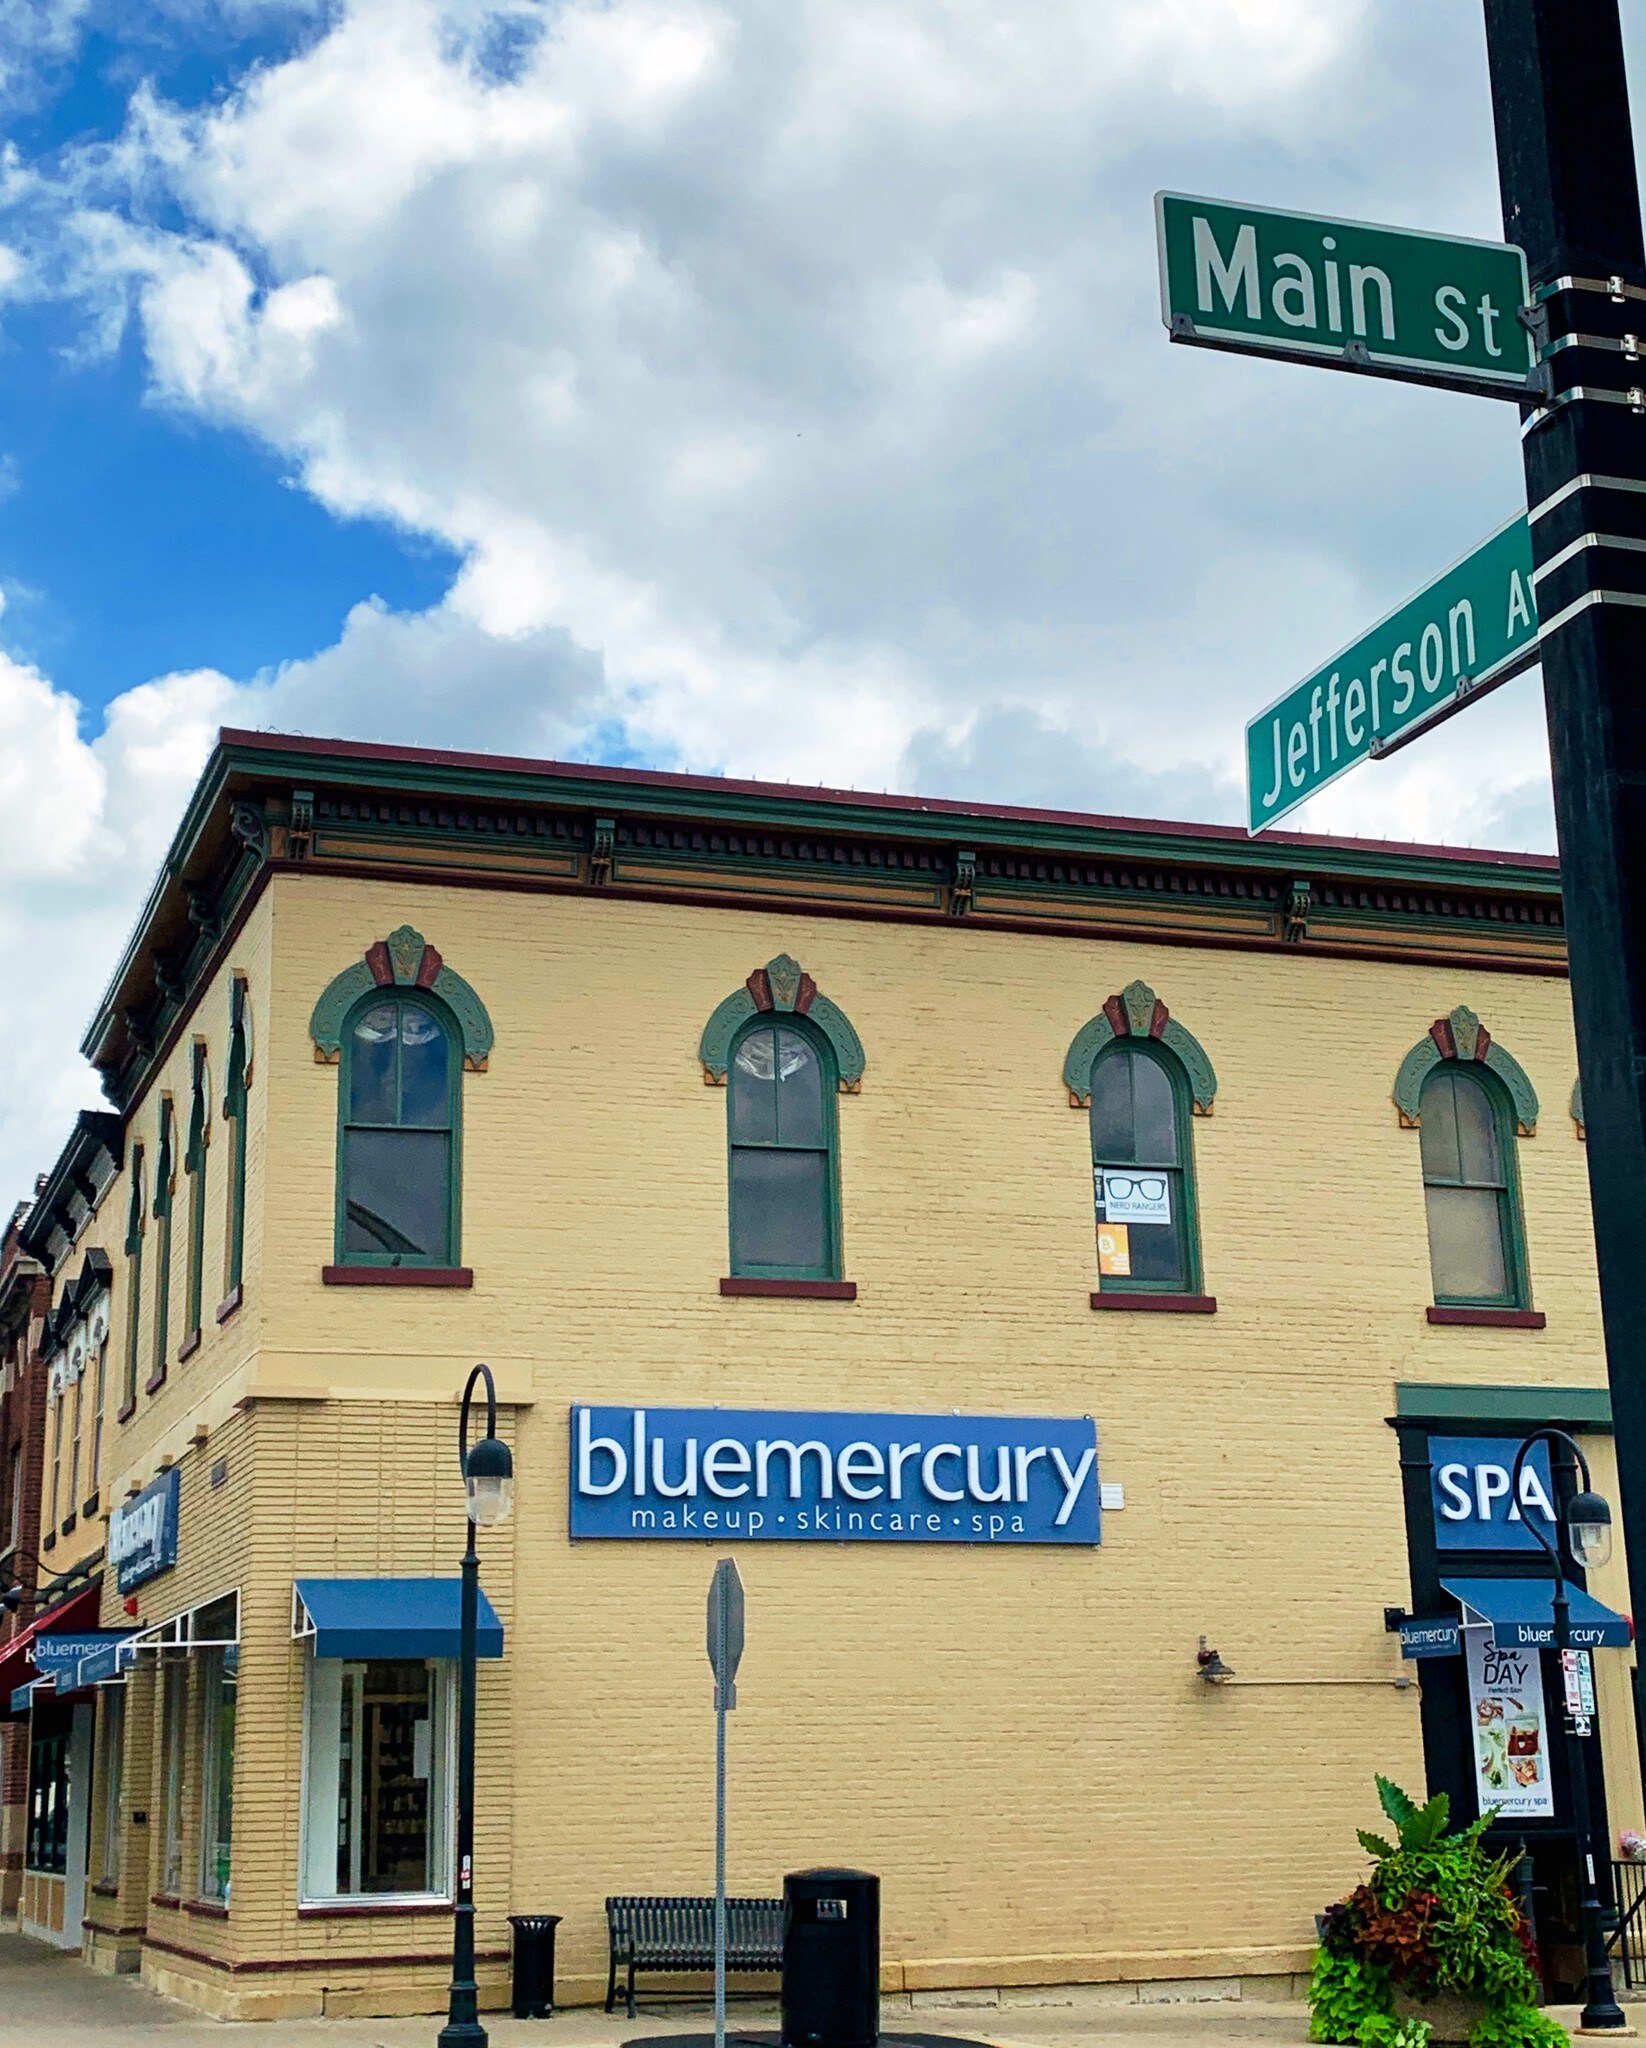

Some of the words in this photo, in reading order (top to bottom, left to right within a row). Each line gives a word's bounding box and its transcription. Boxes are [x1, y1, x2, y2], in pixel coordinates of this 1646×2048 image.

[1192, 217, 1395, 341] Main
[1435, 285, 1502, 357] St
[1262, 598, 1476, 808] Jefferson
[1110, 1201, 1130, 1210] NERD
[1132, 1202, 1167, 1211] RANGERS
[578, 1408, 1097, 1526] bluemercury
[1438, 1463, 1557, 1521] SPA
[631, 1503, 764, 1536] makeup
[797, 1504, 942, 1532] skincare
[971, 1514, 1025, 1539] spa
[1399, 1627, 1458, 1645] bluemercury
[1518, 1625, 1605, 1645] bluercury
[1483, 1640, 1521, 1671] Spa
[1484, 1663, 1529, 1685] DAY
[1533, 1797, 1548, 1806] spa
